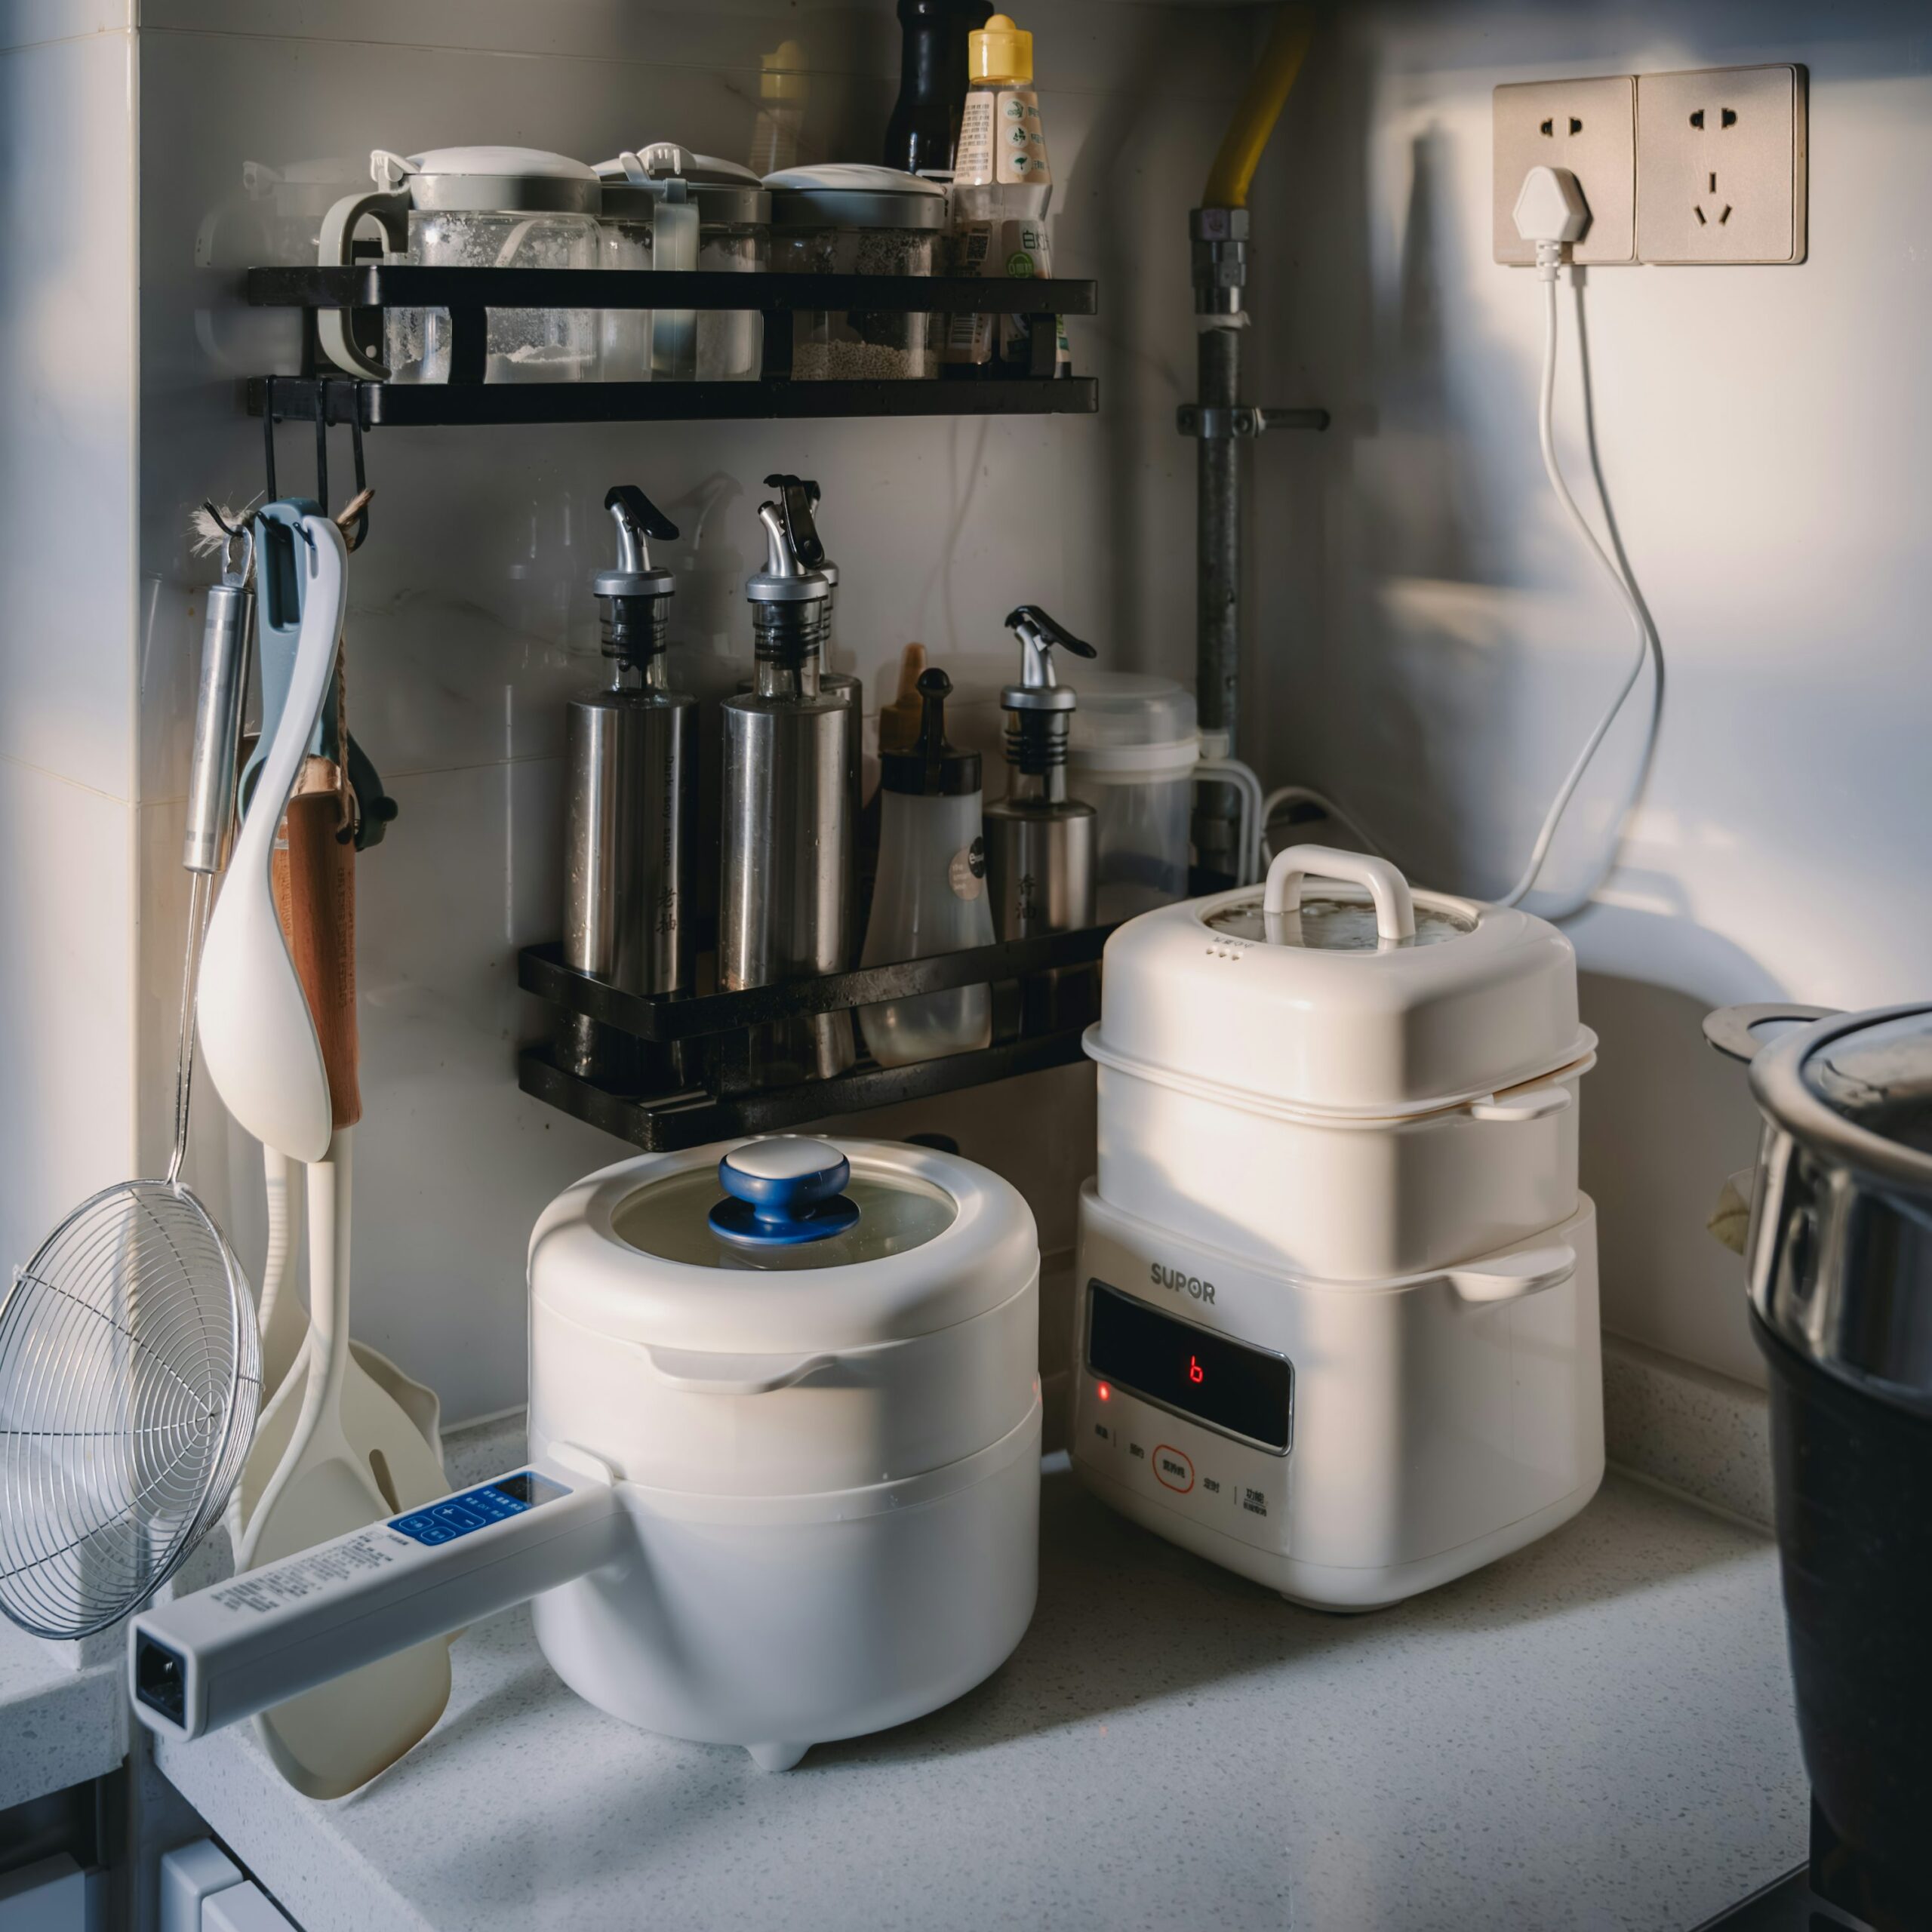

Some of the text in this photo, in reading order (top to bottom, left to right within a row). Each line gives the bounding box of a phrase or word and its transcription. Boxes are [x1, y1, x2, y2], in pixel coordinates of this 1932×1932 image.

[662, 755, 675, 867] Dark soy sauce
[655, 886, 678, 935] 老抽
[1151, 1263, 1215, 1305] SUPOR
[1245, 1487, 1265, 1504] 功能
